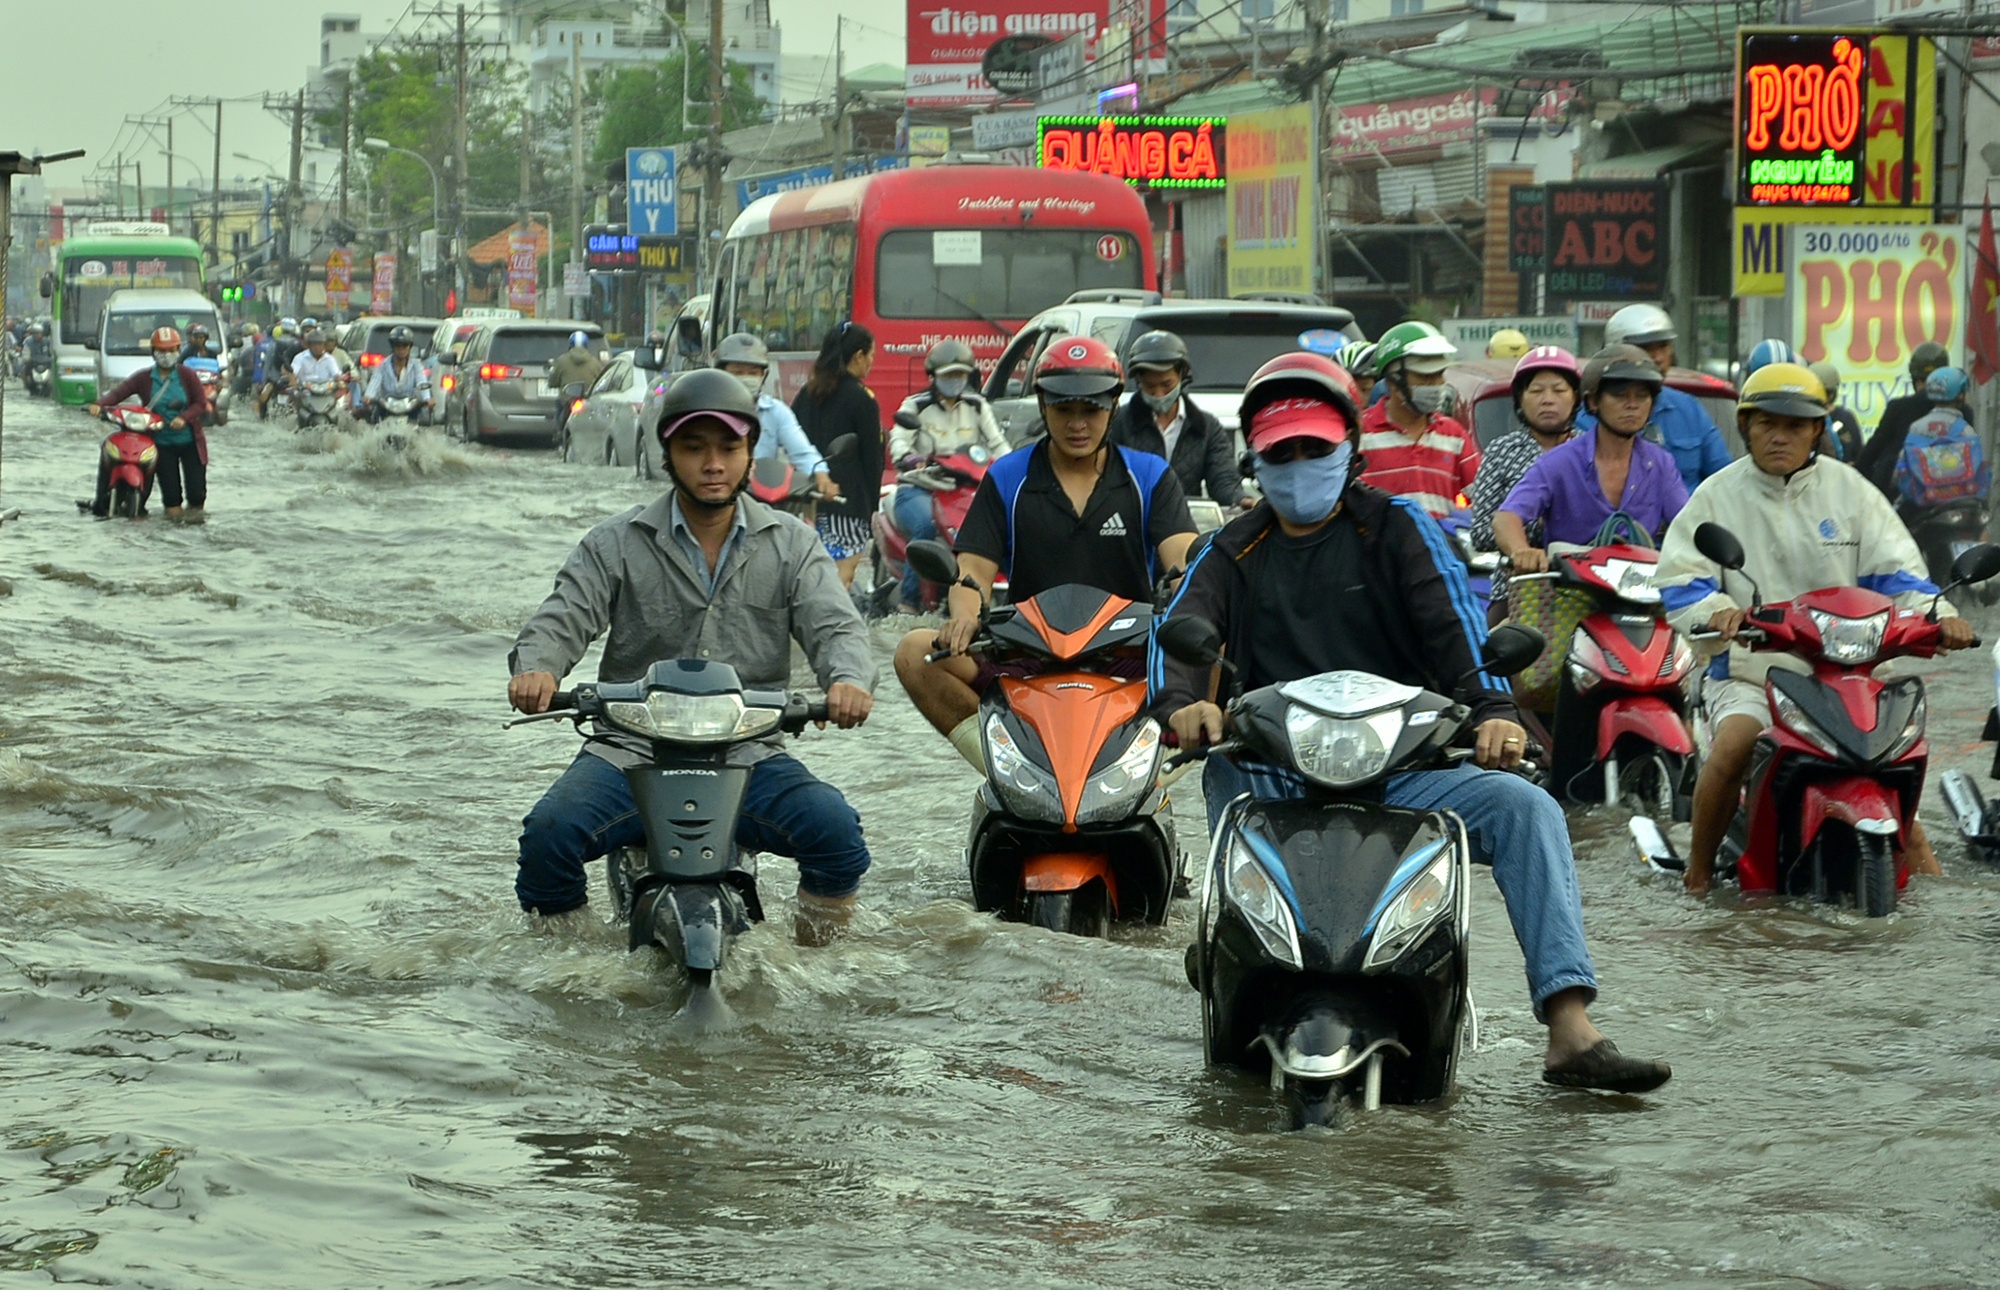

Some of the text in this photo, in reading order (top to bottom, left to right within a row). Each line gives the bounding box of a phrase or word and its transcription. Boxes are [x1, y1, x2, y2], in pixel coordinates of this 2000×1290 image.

[920, 8, 998, 38] điện
[1004, 12, 1096, 38] quang
[1747, 38, 1862, 150] PHỞ
[1043, 119, 1167, 178] QUẢNG
[631, 172, 673, 203] THÚ
[958, 196, 1096, 214] Intellect and Heritage
[645, 208, 659, 233] Y
[639, 242, 665, 267] THÚ
[669, 246, 679, 266] Y
[1101, 240, 1118, 256] 11
[1553, 219, 1655, 266] ABC
[1800, 231, 1956, 363] PHỞ
[921, 335, 940, 347] THE
[1099, 527, 1127, 536] adidas
